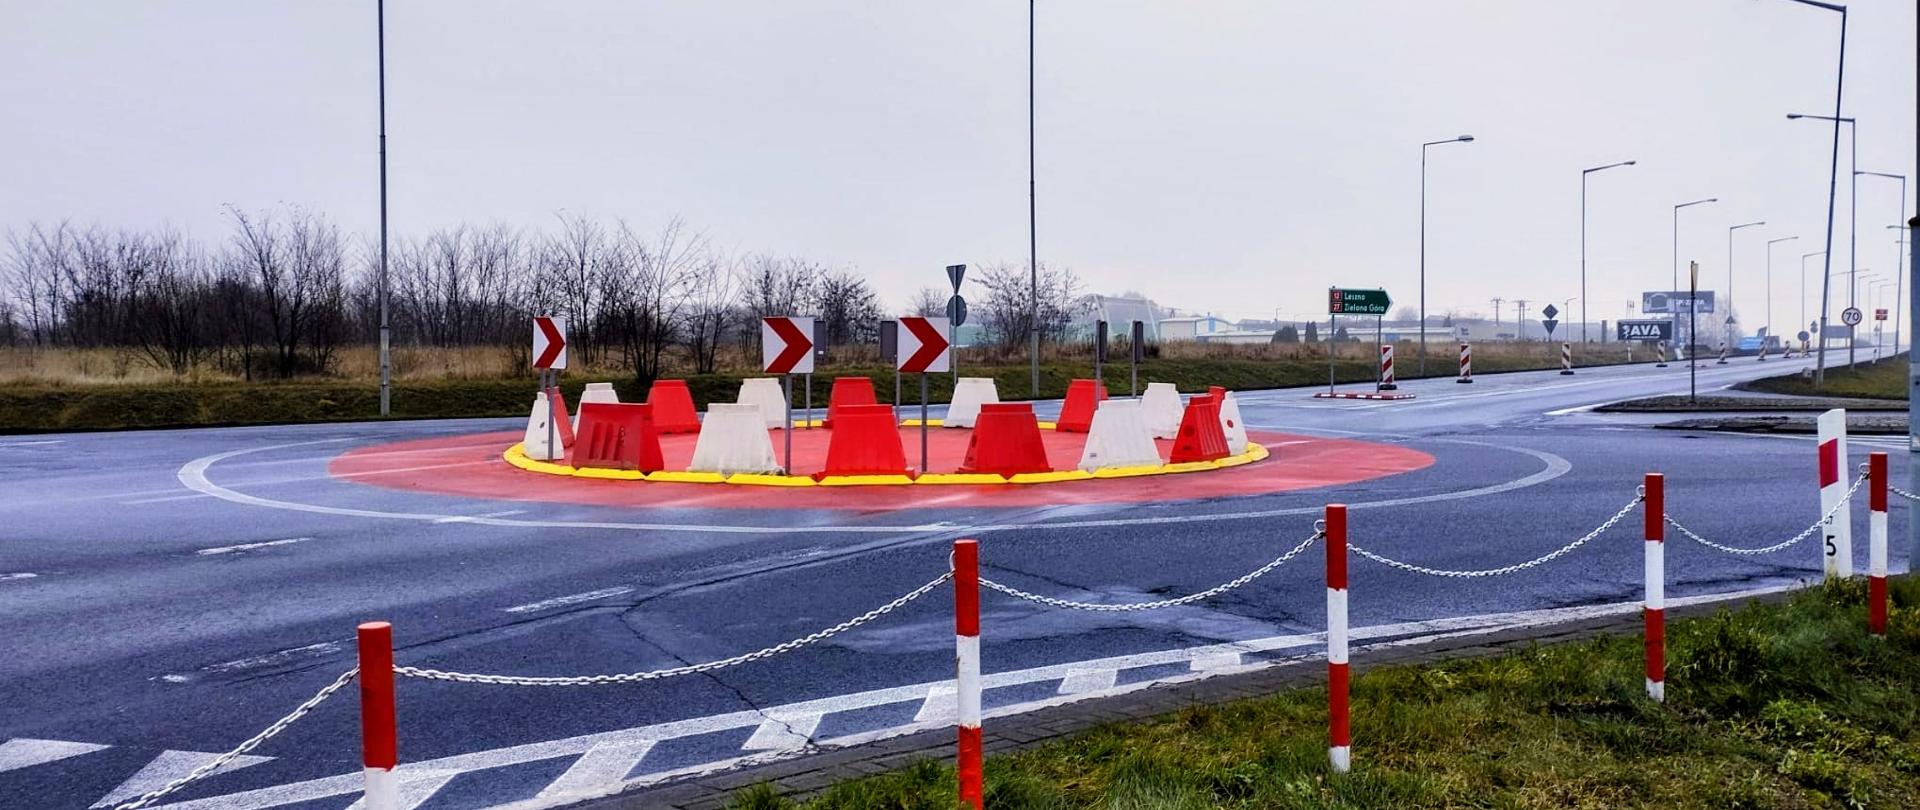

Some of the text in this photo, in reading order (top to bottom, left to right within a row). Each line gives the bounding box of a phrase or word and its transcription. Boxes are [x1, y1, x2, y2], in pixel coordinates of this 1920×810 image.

[1344, 292, 1366, 300] Leszno
[1333, 303, 1385, 312] 27 Zielona Góra
[1845, 311, 1859, 321] 70
[1826, 535, 1837, 557] 5
